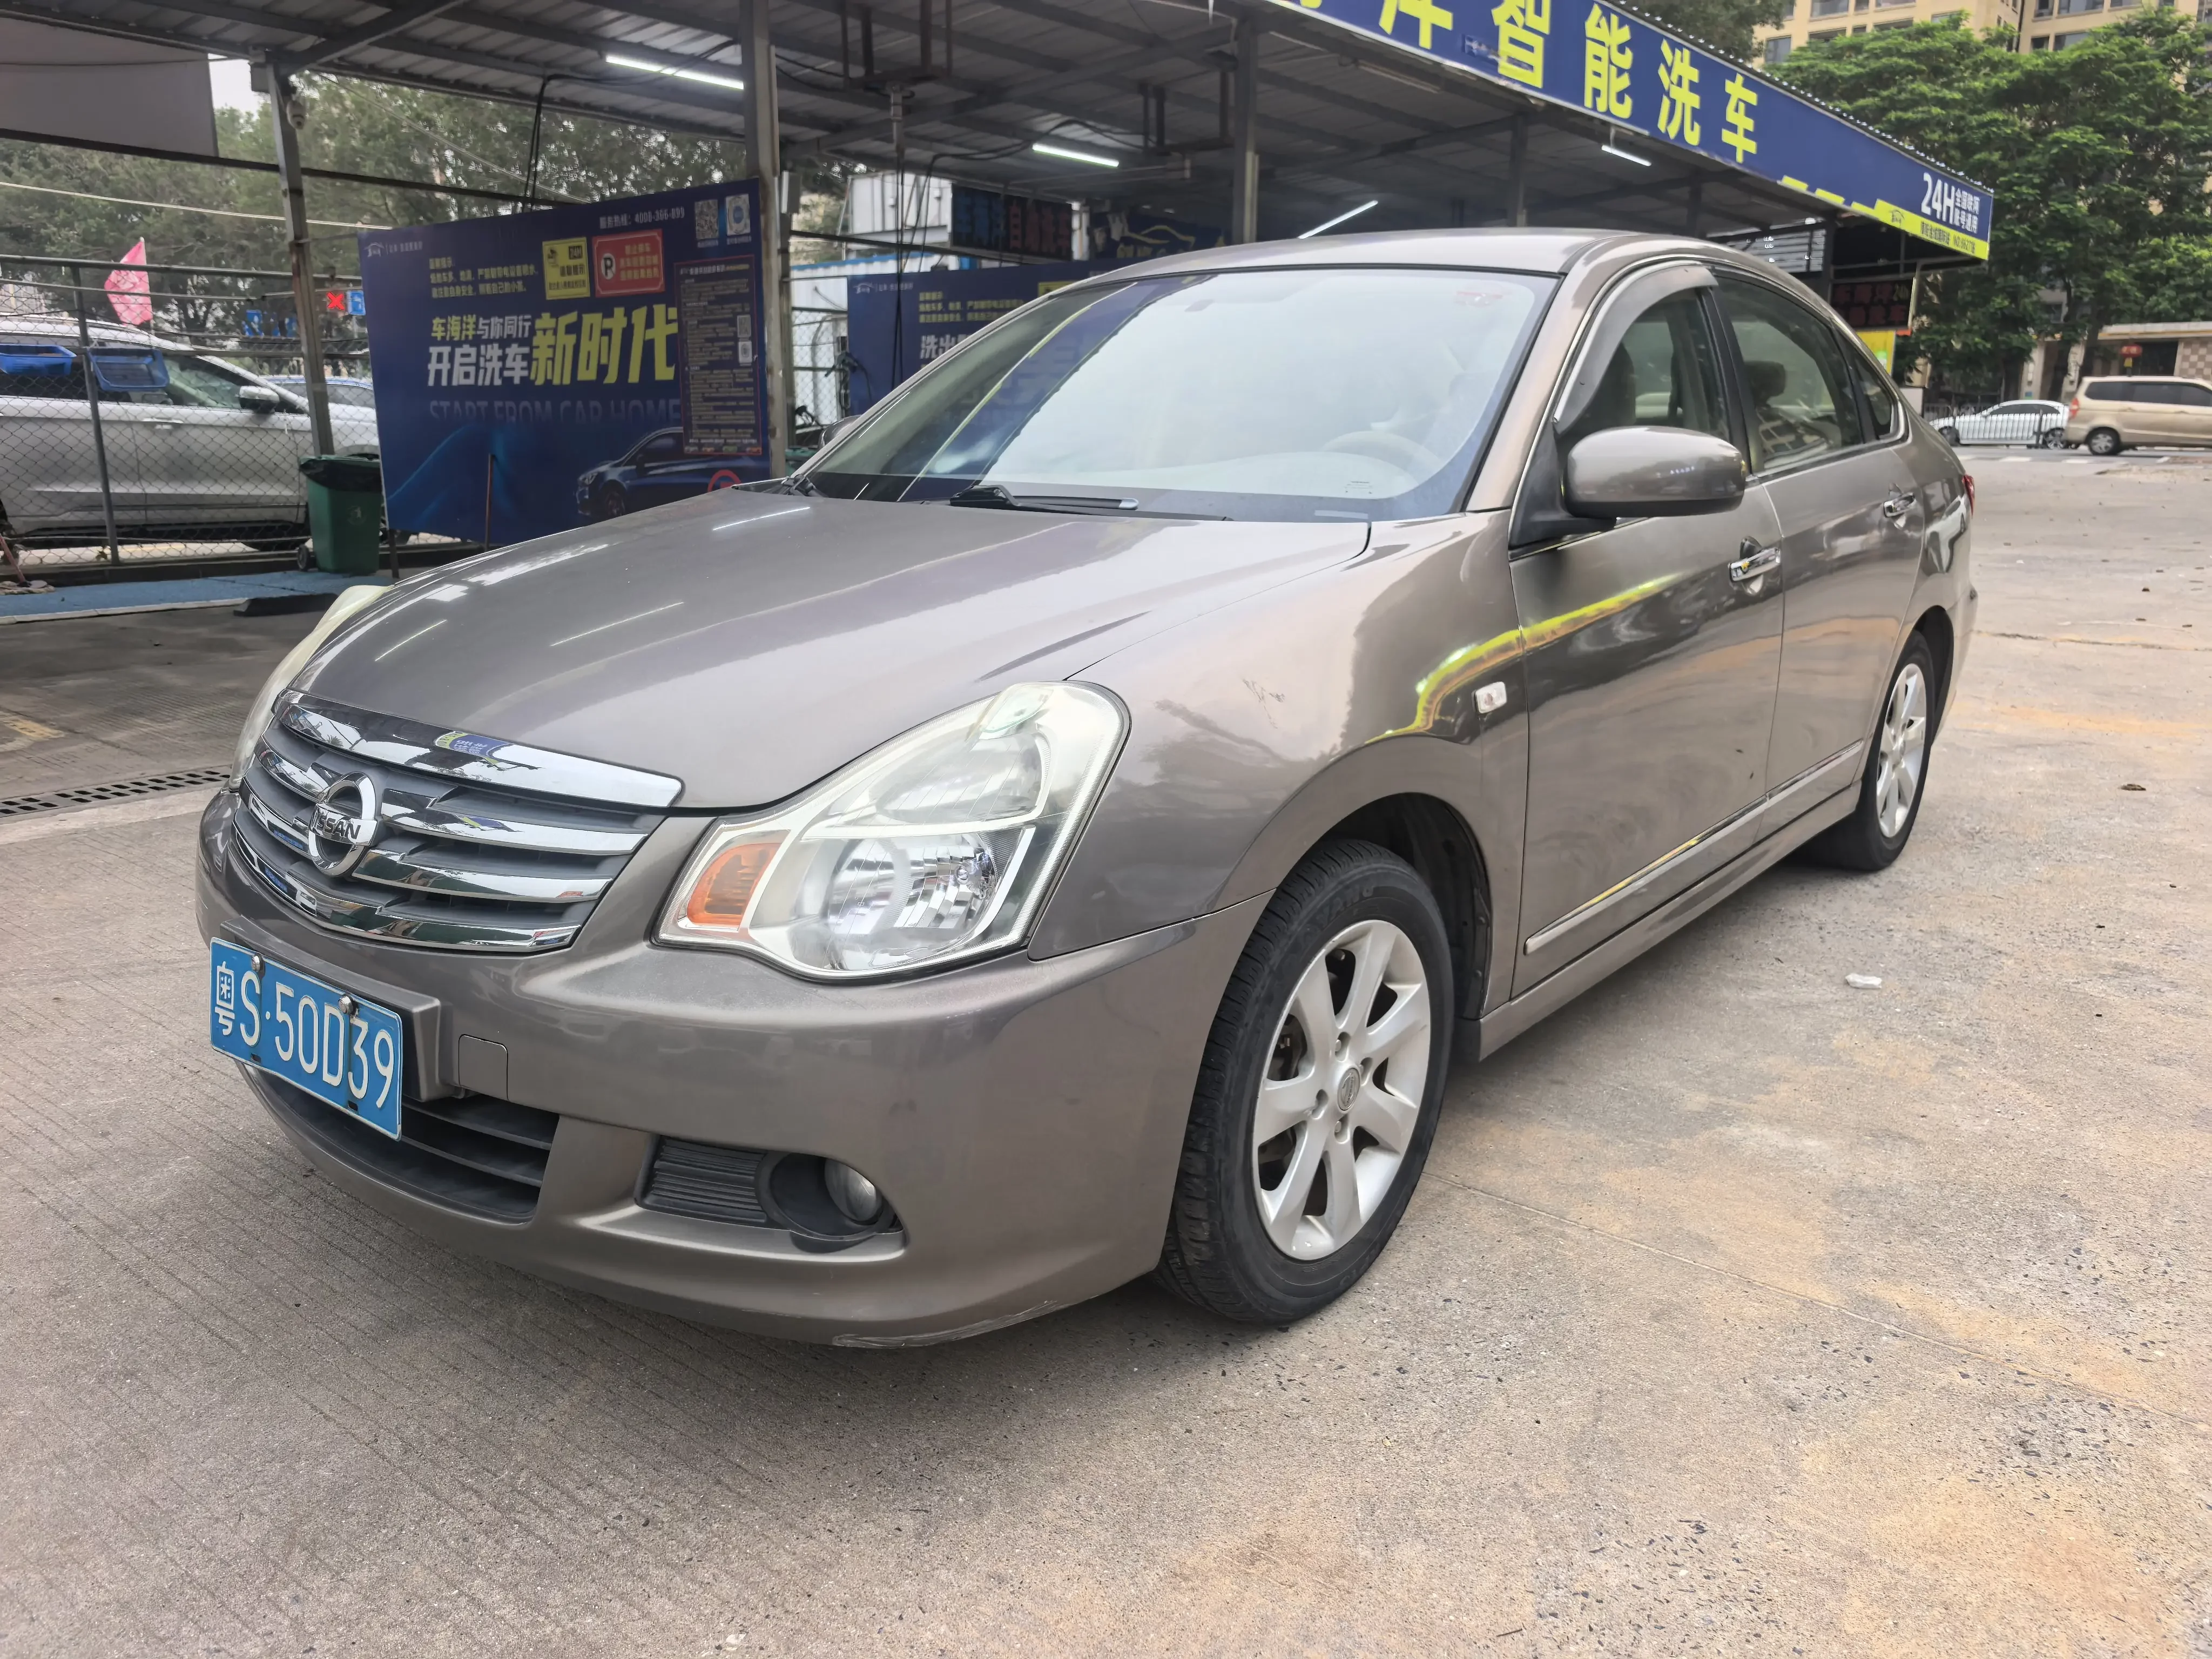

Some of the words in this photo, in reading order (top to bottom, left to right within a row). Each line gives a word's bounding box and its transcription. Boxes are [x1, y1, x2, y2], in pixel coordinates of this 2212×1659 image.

[1300, 0, 1758, 163] 智能洗车
[1921, 172, 1955, 224] 24H
[431, 314, 532, 341] 车海洋与你同行
[430, 400, 488, 422] START
[494, 400, 552, 423] FROM
[611, 398, 681, 423] HOME
[214, 960, 395, 1109] 粤S·50D39
